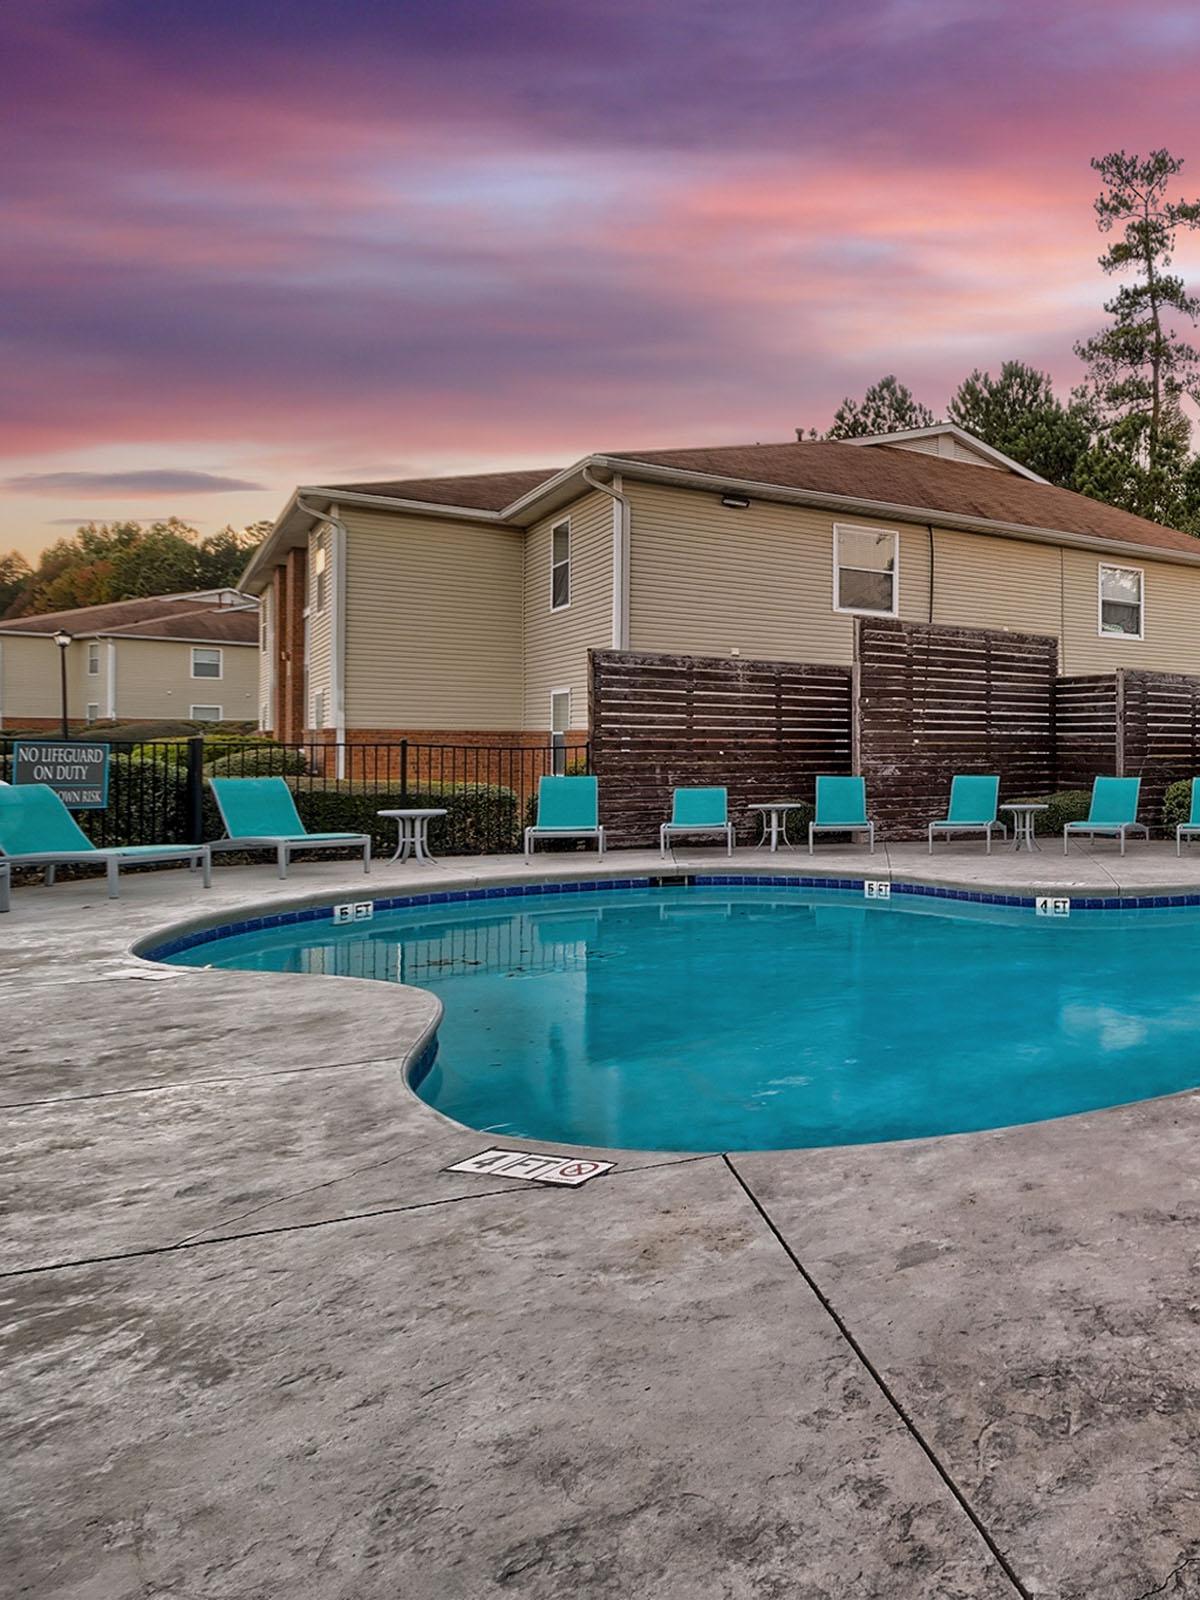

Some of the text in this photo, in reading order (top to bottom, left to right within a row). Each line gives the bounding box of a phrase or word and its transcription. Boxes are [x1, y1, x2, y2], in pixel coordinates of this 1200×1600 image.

[19, 747, 104, 763] NO LIFEGUARD
[33, 765, 89, 780] ON DUTY
[58, 790, 102, 803] OWN RISK
[471, 1154, 564, 1175] 4 FT
